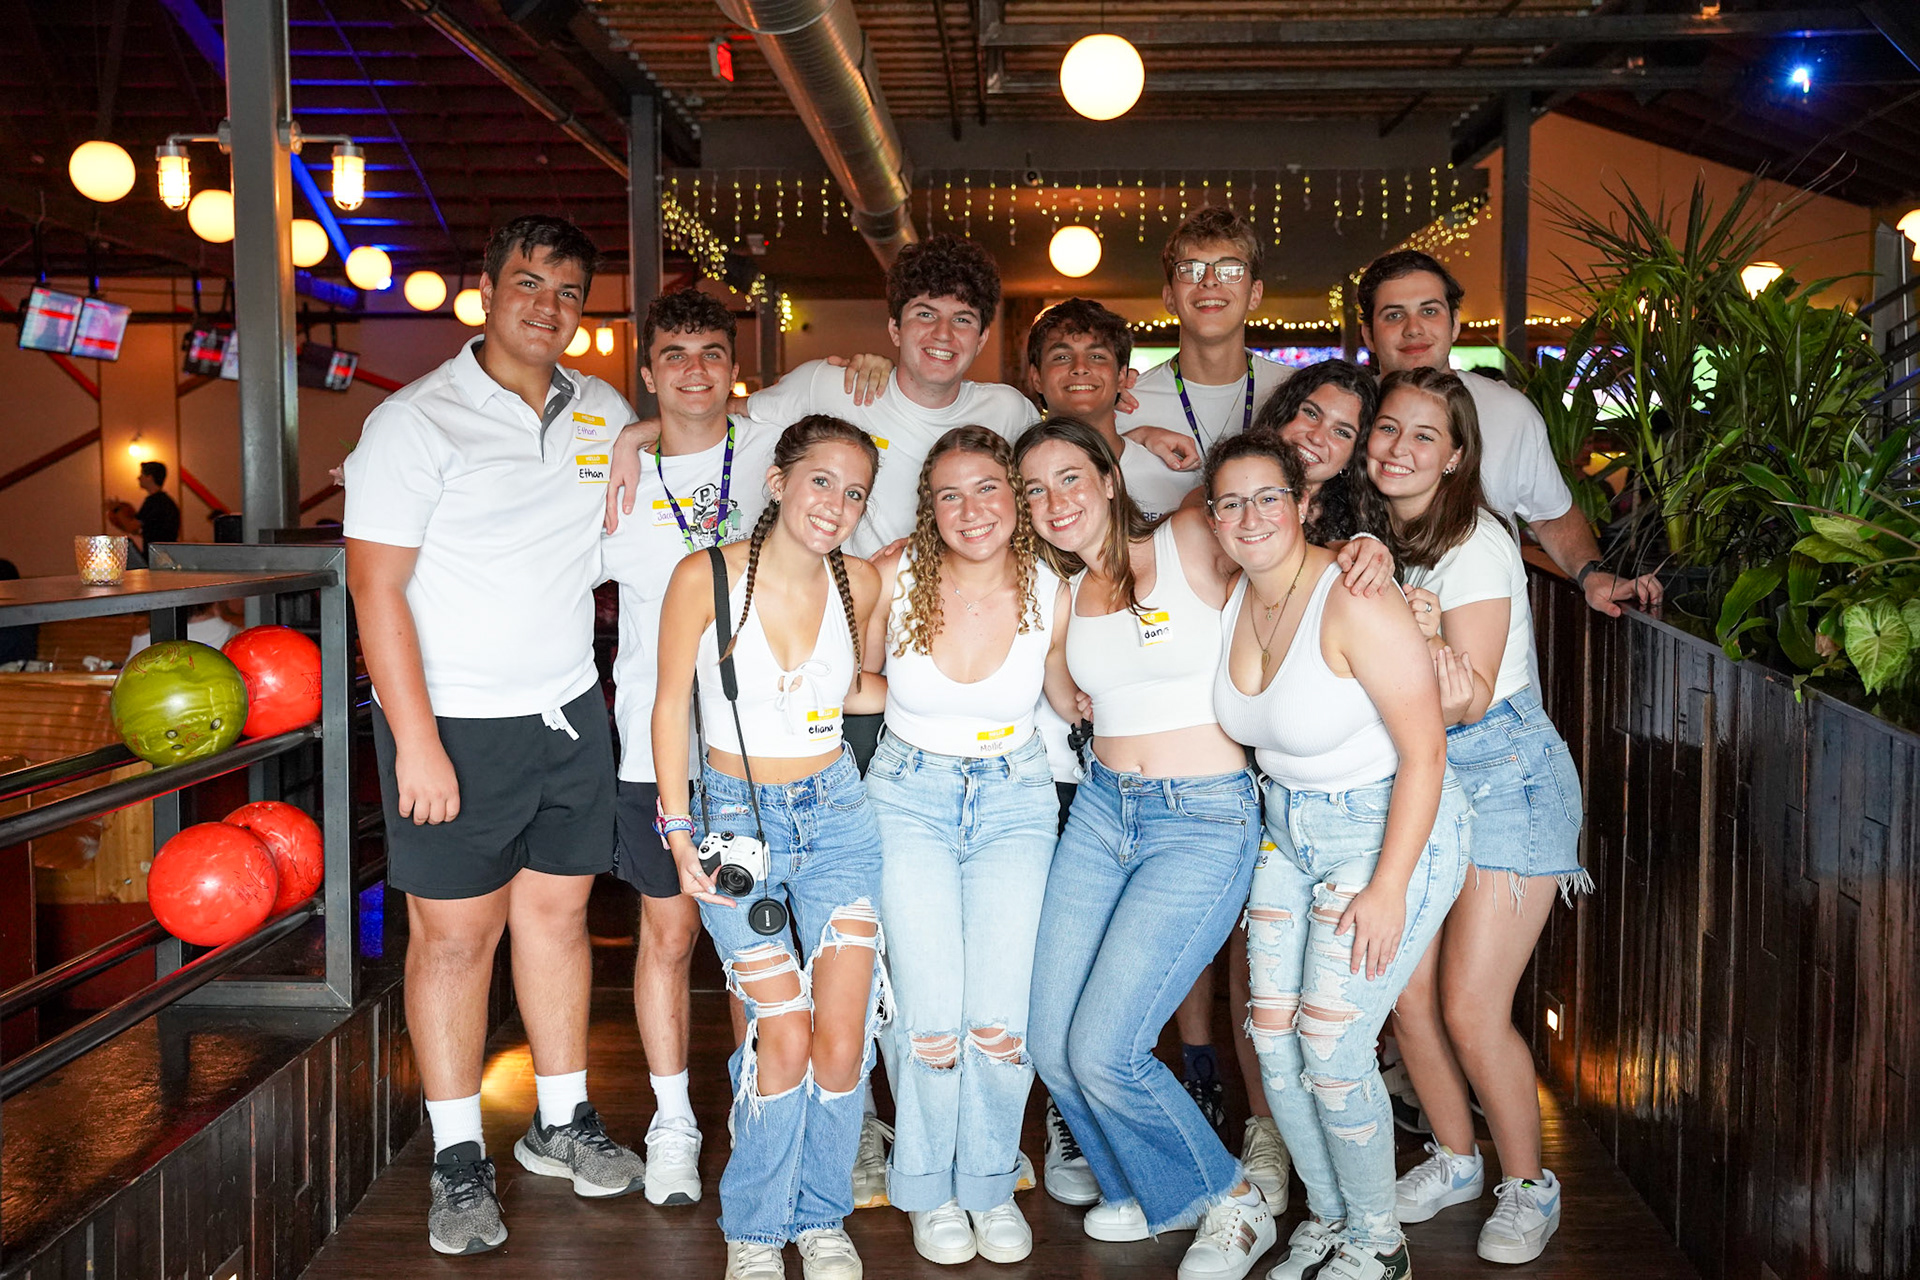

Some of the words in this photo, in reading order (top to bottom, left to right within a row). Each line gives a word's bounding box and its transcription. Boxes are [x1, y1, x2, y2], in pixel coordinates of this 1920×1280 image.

[577, 426, 597, 436] Ethan
[579, 468, 604, 479] Ethan
[700, 487, 710, 502] P
[808, 724, 834, 734] eliana
